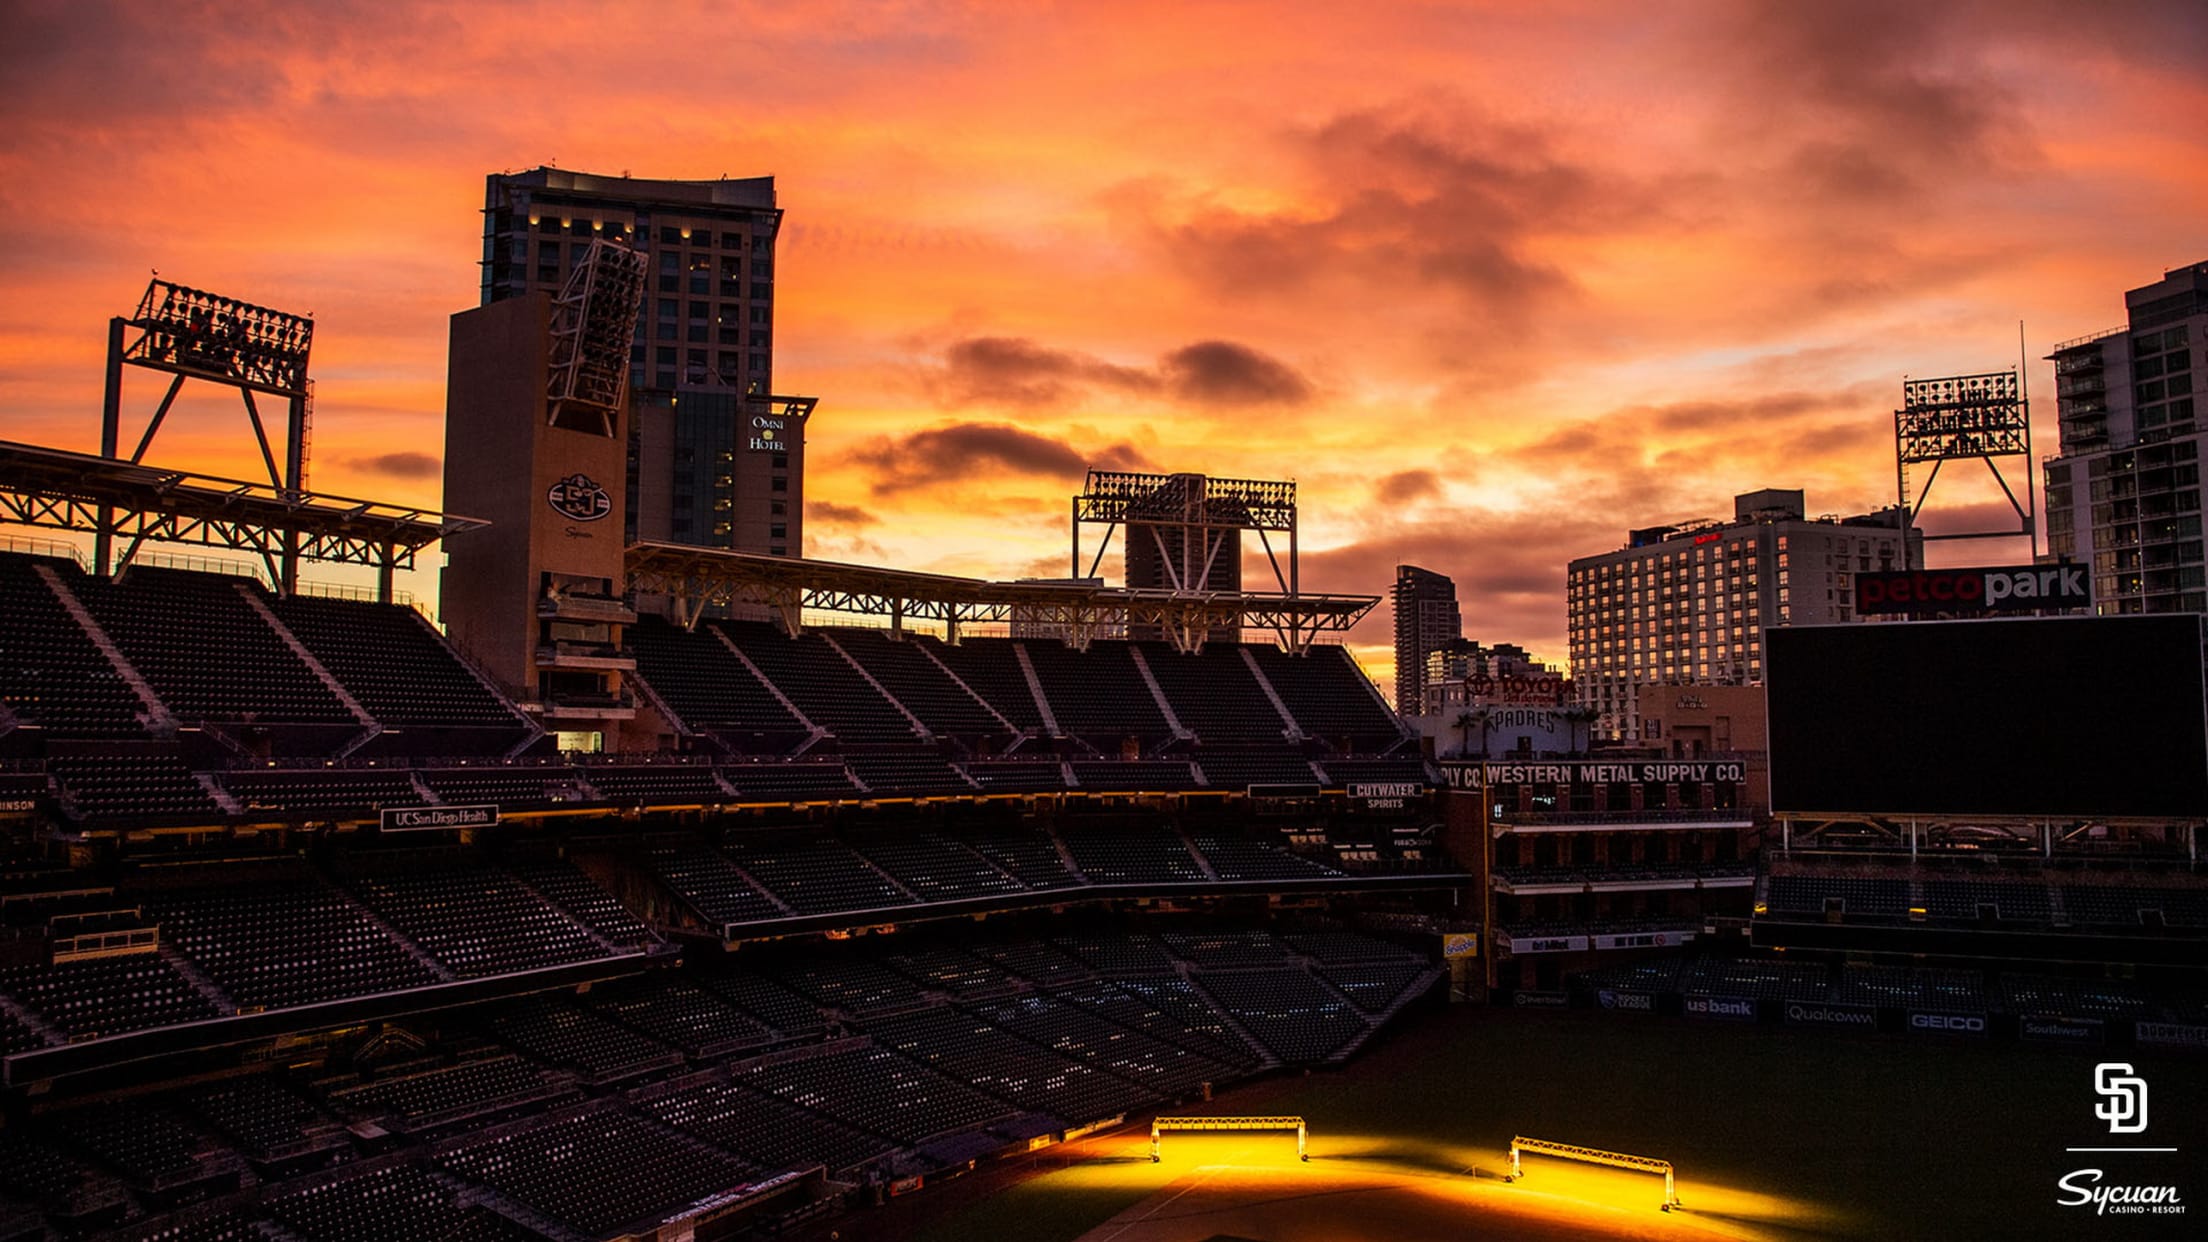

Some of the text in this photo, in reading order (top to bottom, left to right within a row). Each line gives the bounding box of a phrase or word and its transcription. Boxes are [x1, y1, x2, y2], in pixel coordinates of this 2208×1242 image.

[752, 416, 784, 430] OMNI
[750, 438, 786, 451] HOTEL
[1502, 677, 1576, 694] TOYOTA
[1495, 710, 1554, 733] PADRES
[1486, 764, 1744, 784] WESTERN METAL SUPPLY CO.
[1356, 783, 1415, 797] CUTWATER
[0, 800, 35, 811] INSON
[1367, 799, 1404, 809] SPIRITS
[432, 810, 458, 825] Diego
[459, 809, 489, 824] Health
[1788, 1005, 1873, 1024] Qualcomm
[1911, 1014, 1985, 1031] GEICO
